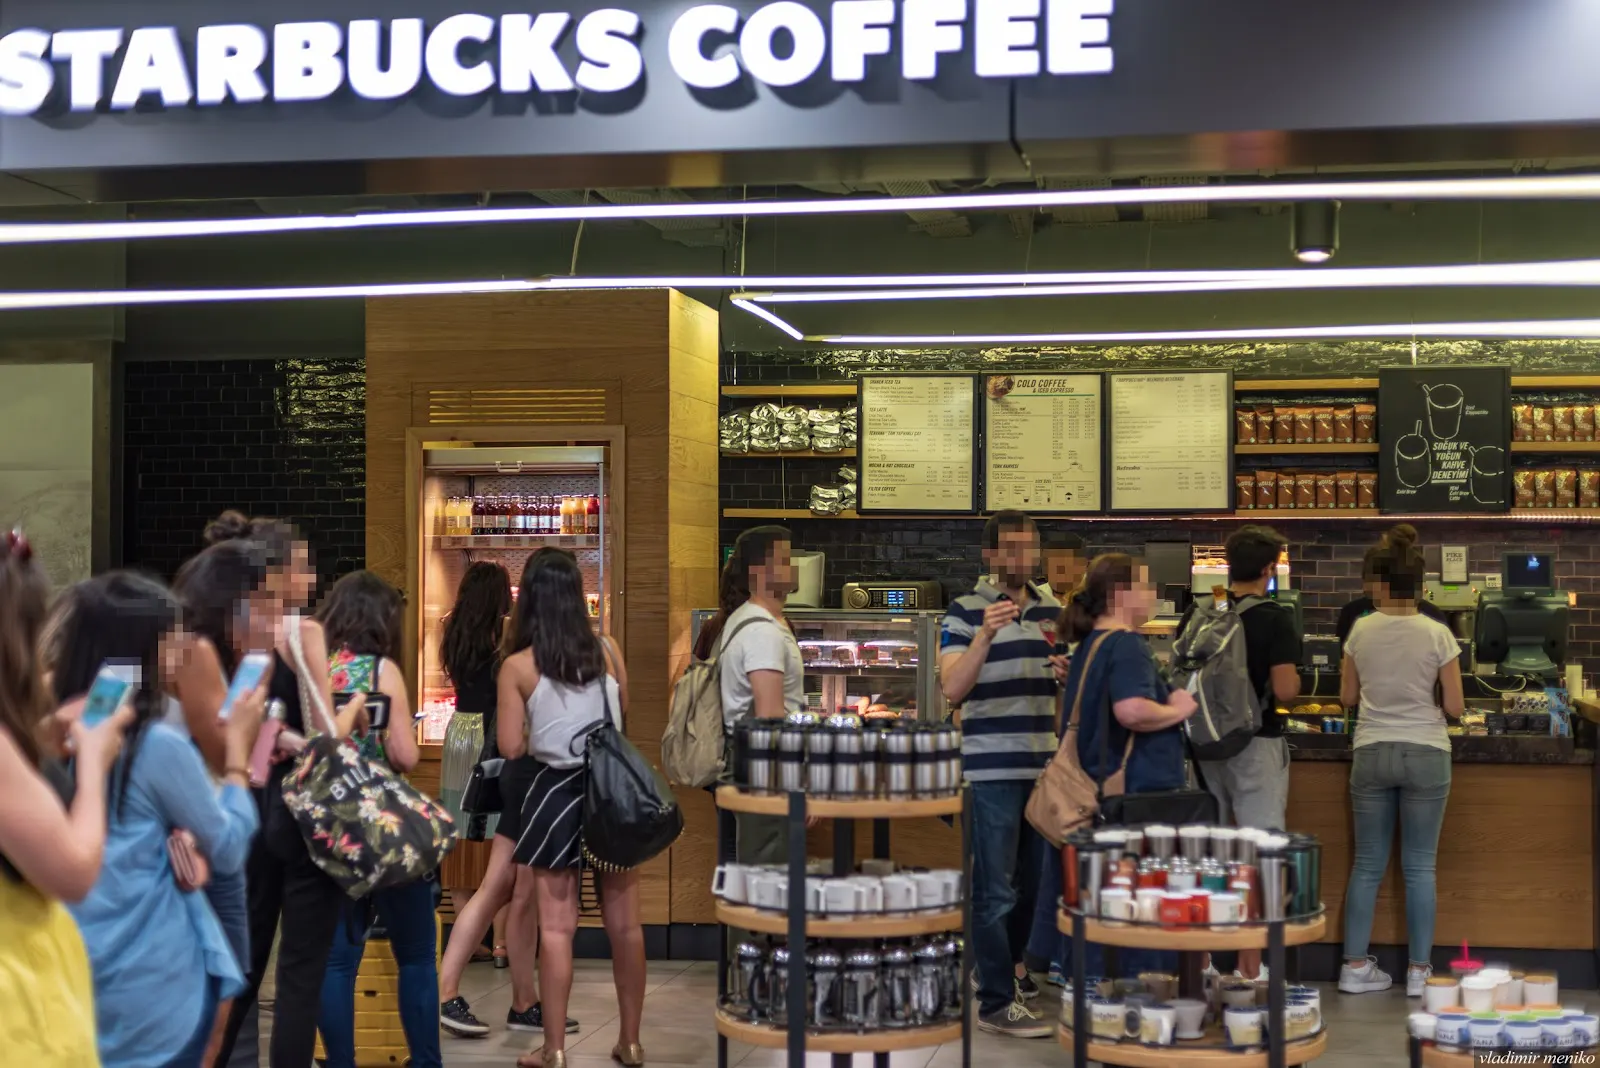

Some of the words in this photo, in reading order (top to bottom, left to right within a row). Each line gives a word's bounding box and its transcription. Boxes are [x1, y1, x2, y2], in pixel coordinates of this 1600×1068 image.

[0, 8, 643, 116] STARBUCKS
[668, 0, 1114, 88] COFFEE
[1017, 380, 1036, 388] COLD
[1038, 380, 1068, 388] COFFEE
[1433, 440, 1458, 450] SOĞUK
[1459, 442, 1469, 450] VE
[1436, 450, 1461, 460] YOĞUN
[1441, 461, 1466, 469] KAHVE
[1432, 469, 1469, 479] DENEYİMİ
